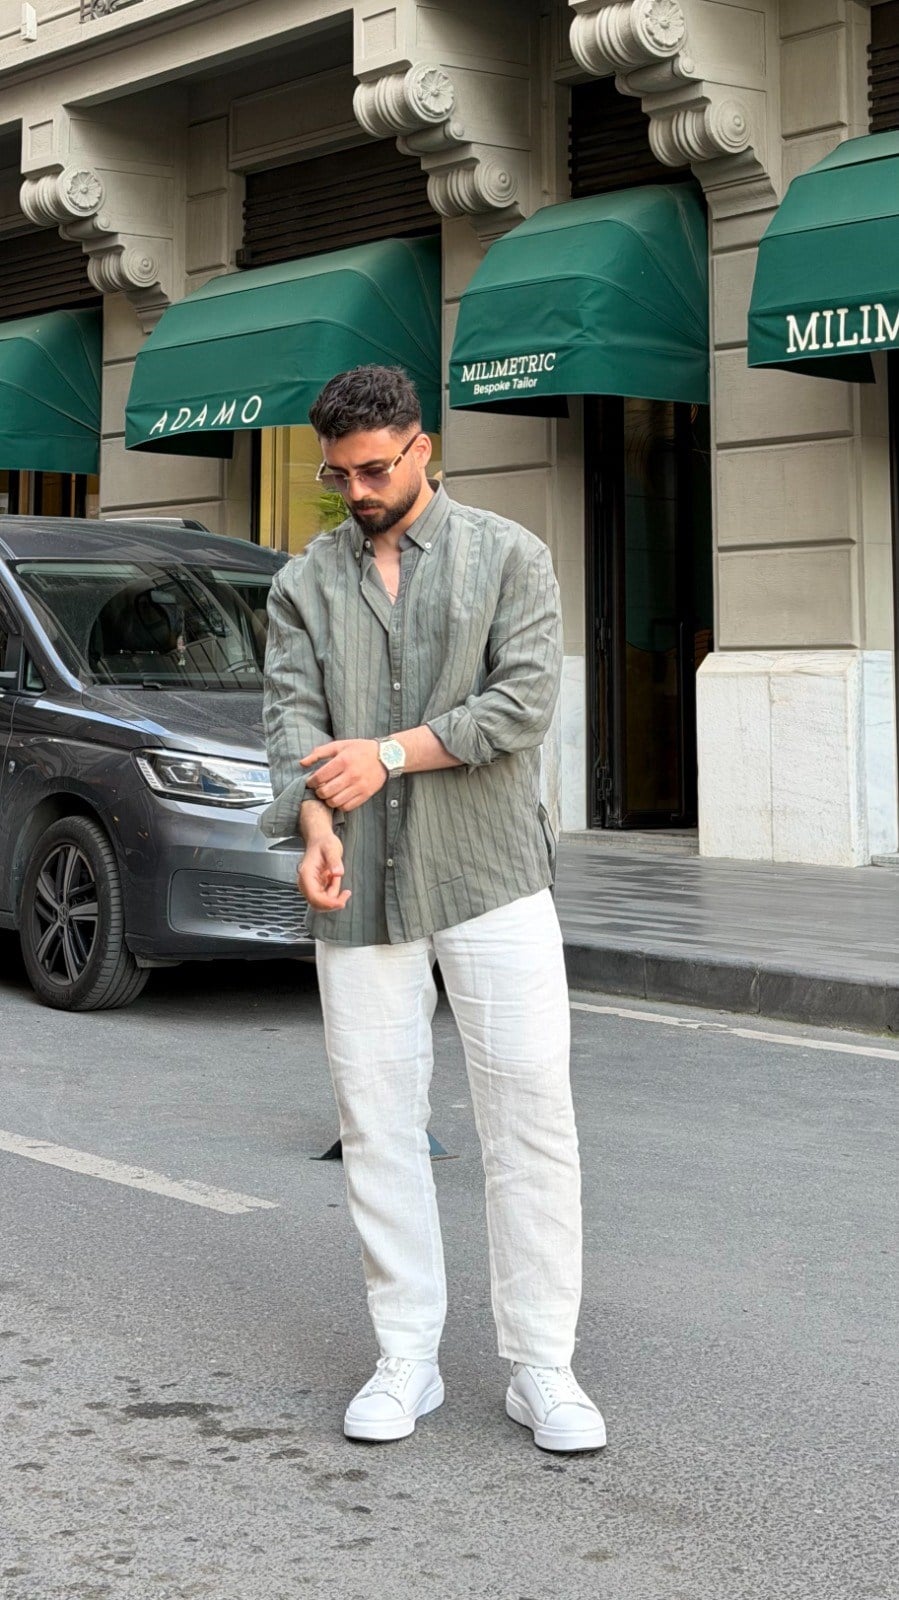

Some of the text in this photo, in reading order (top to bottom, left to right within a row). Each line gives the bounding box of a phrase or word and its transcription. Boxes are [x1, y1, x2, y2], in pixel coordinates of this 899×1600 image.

[461, 352, 556, 382] MILIMETRIC
[473, 376, 538, 396] Bespoke Tailor
[149, 395, 262, 435] ADAMO
